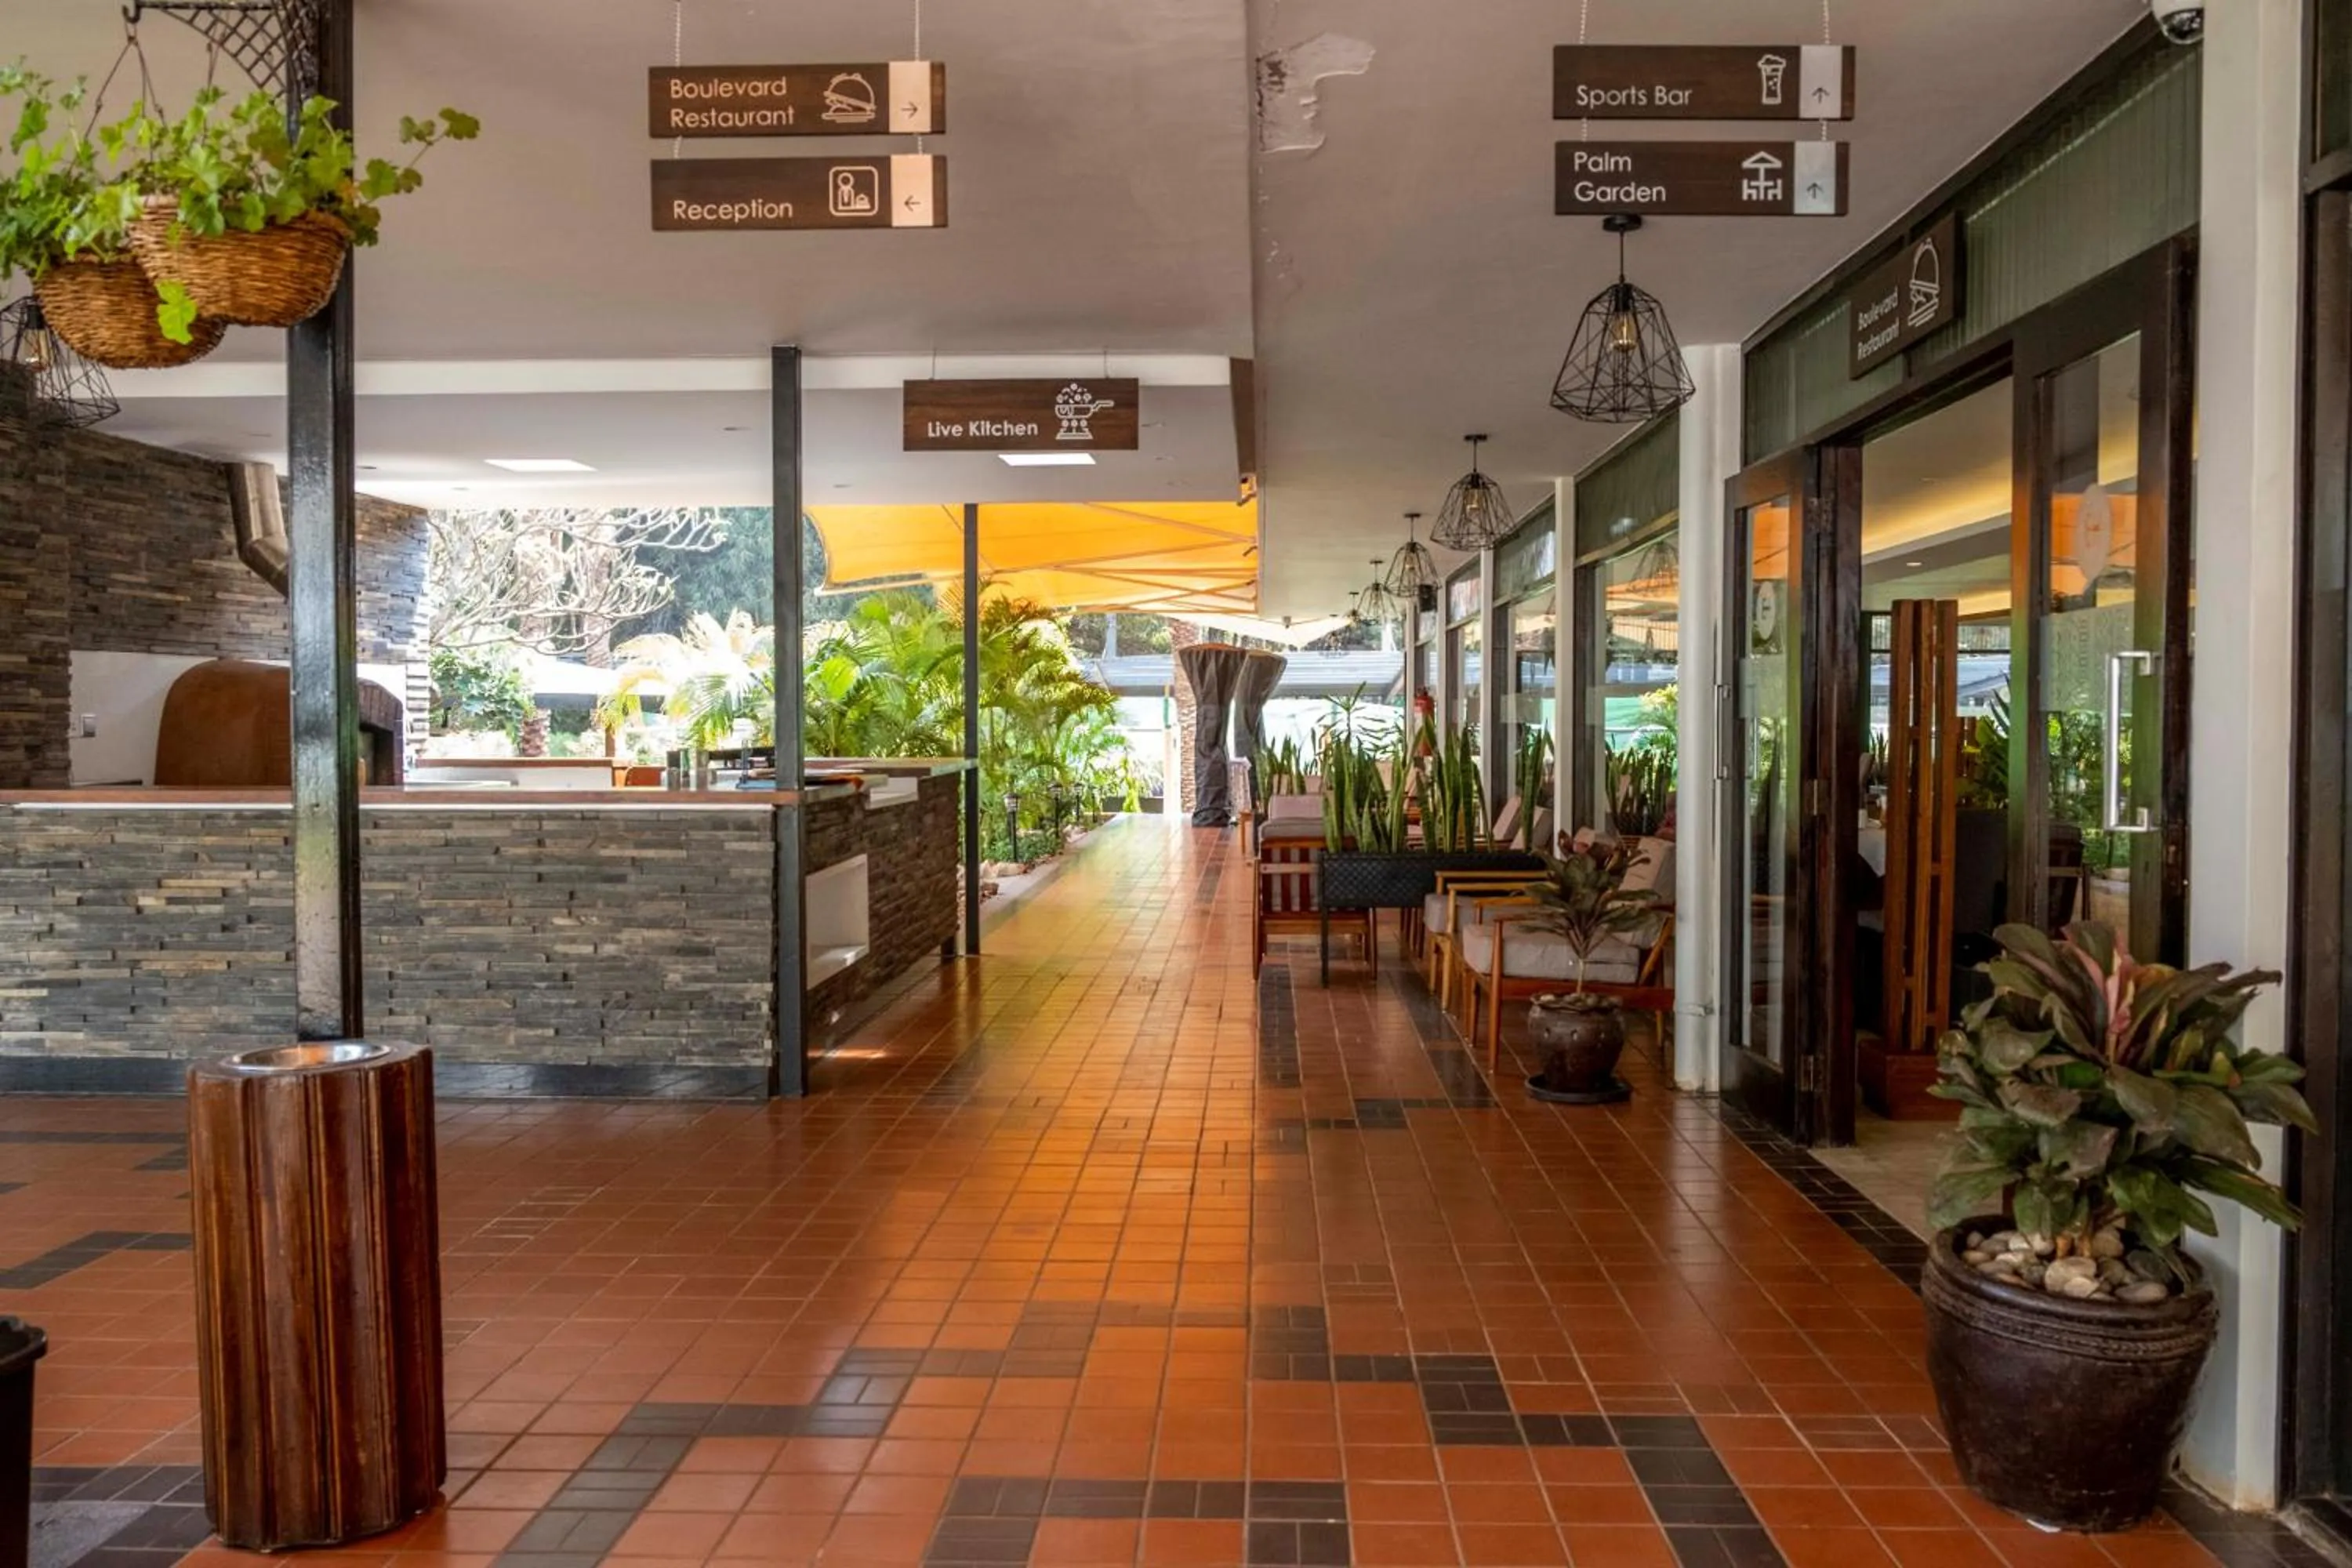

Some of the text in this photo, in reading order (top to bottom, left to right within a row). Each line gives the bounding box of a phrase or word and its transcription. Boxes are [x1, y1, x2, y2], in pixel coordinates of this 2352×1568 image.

[670, 76, 787, 99] Boulevard
[1576, 84, 1693, 109] Sports Bar
[670, 106, 795, 128] Restaurant
[1574, 151, 1632, 172] Palm
[1574, 180, 1667, 203] Garden
[673, 198, 793, 223] Reception
[1857, 317, 1900, 361] Restaurant
[927, 420, 1039, 437] Live Kitchen
